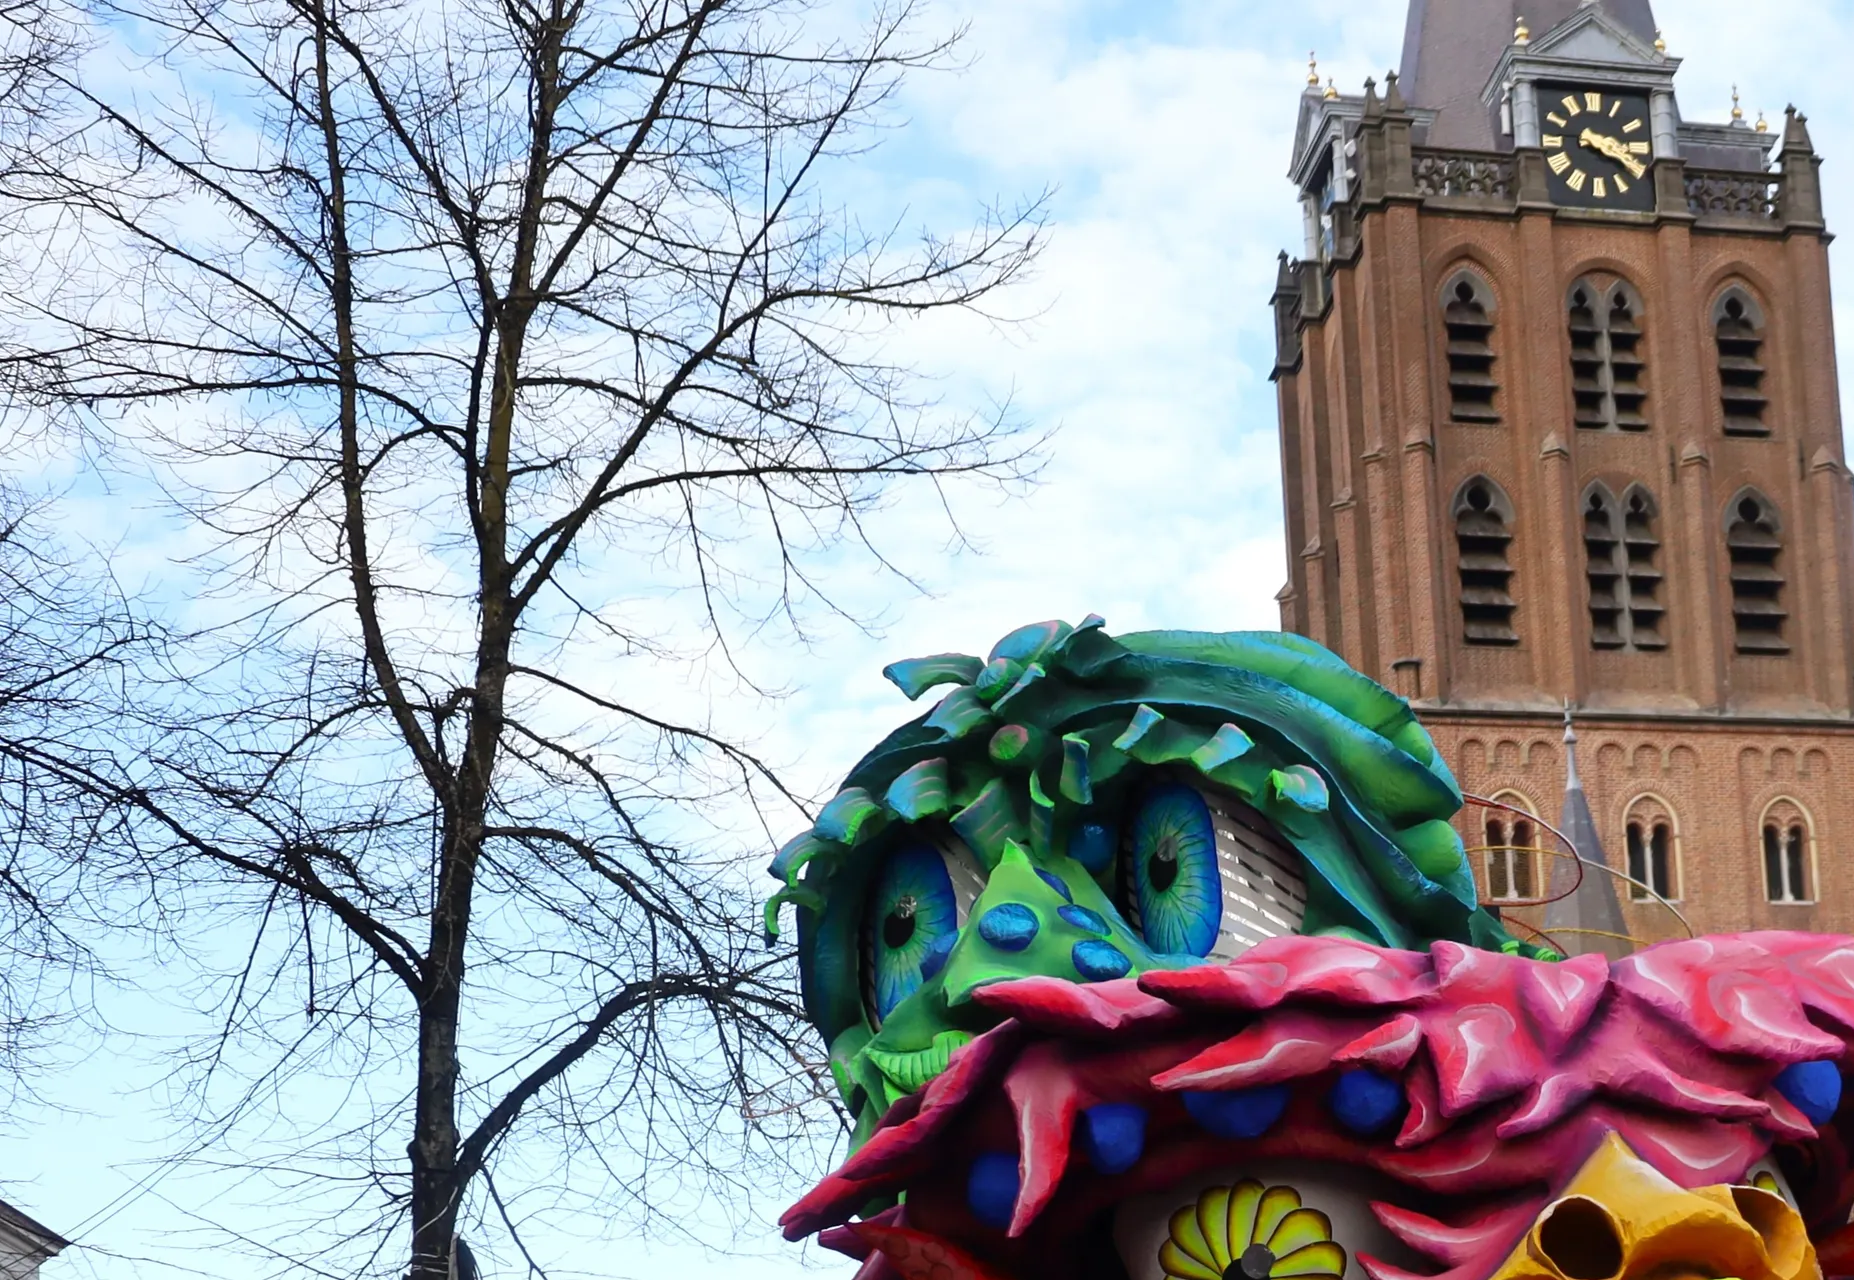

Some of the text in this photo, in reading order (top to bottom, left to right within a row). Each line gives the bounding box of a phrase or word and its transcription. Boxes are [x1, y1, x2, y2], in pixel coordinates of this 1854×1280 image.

[1609, 100, 1621, 118] I
[1622, 119, 1641, 133] II
[1629, 141, 1649, 154] III
